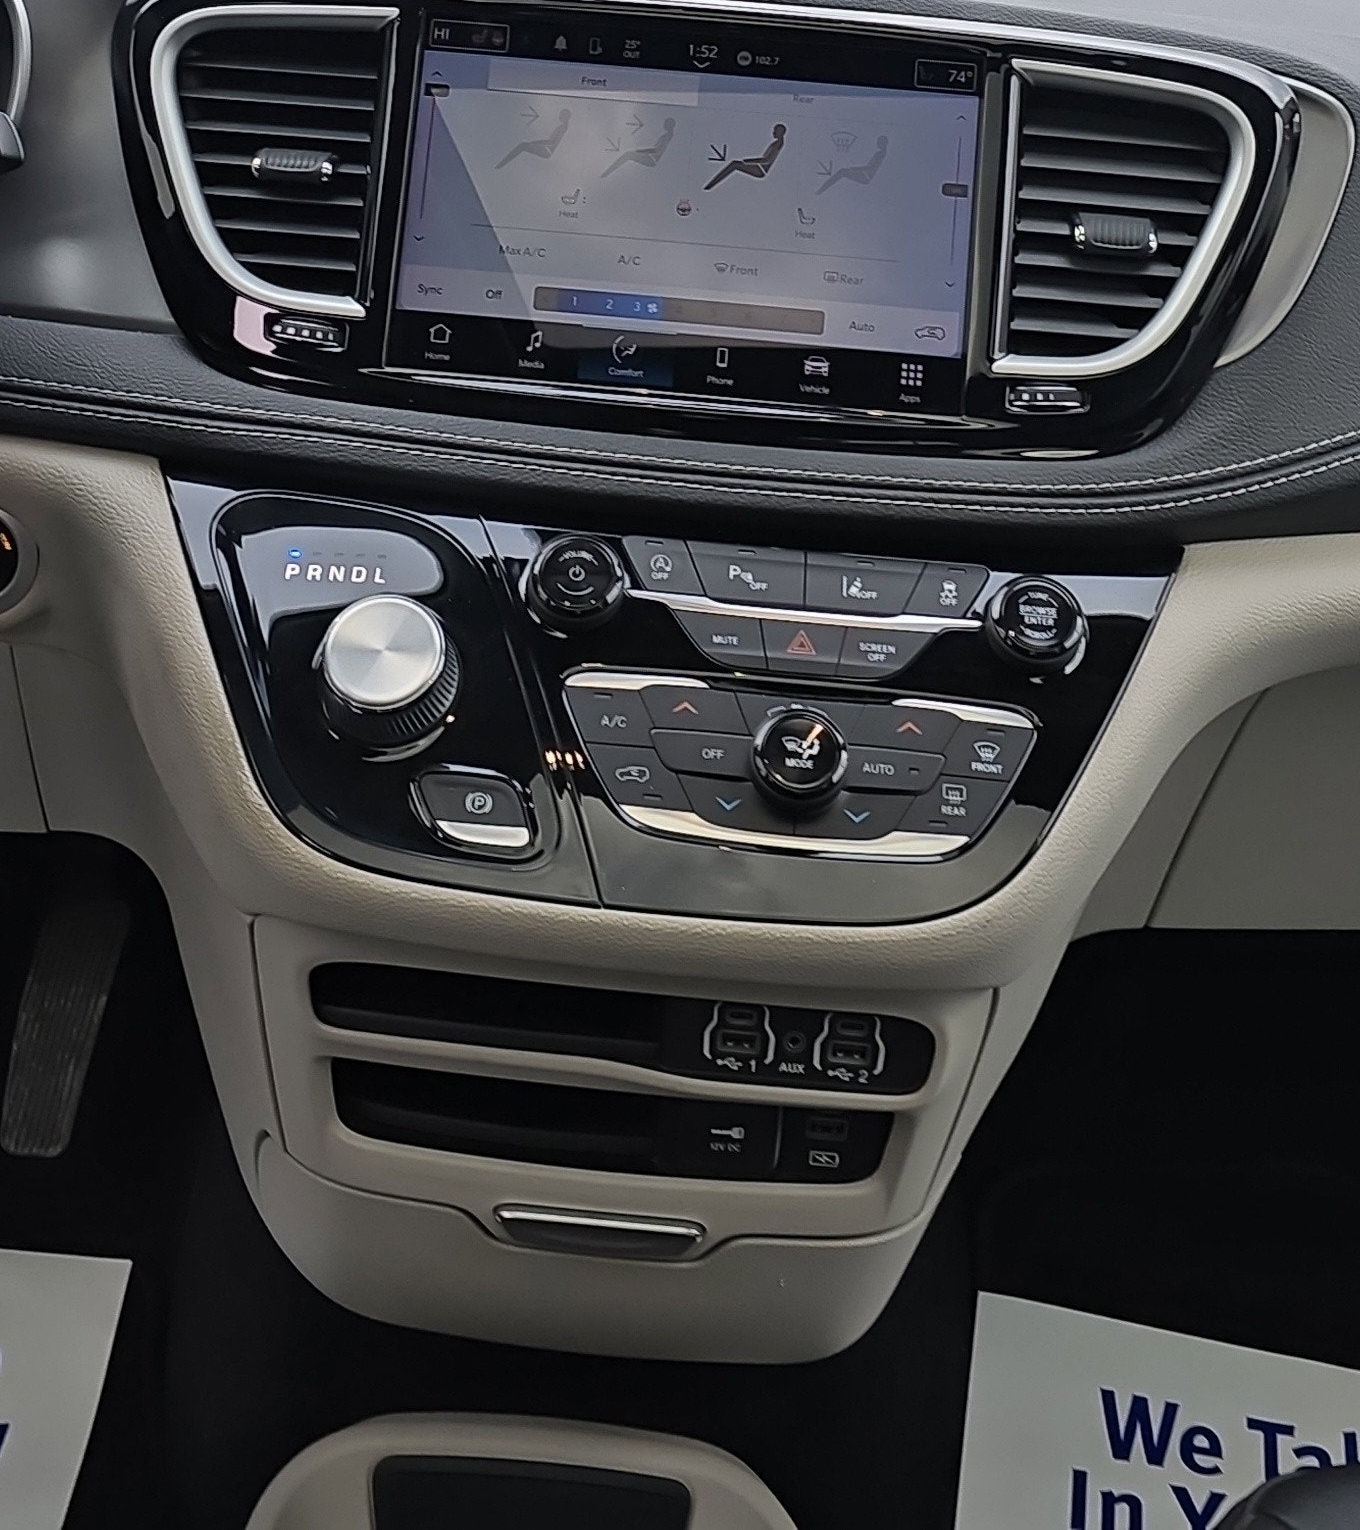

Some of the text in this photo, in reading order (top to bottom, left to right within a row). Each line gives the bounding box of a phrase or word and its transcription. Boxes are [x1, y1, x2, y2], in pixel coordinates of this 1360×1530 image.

[433, 27, 451, 41] HI
[689, 44, 719, 59] 1:52
[755, 55, 780, 66] 102.7
[581, 76, 608, 87] Front
[948, 70, 973, 83] 74°
[792, 94, 815, 104] Rear
[558, 209, 579, 219] Heat
[794, 229, 816, 240] Heat
[499, 244, 547, 258] Max A/C
[617, 254, 642, 266] A/C
[729, 264, 759, 277] Front
[839, 273, 865, 286] Rear
[417, 283, 443, 296] Sync
[485, 289, 504, 300] Off
[605, 298, 614, 310] 2
[848, 321, 875, 333] Auto
[424, 351, 451, 361] Home
[518, 358, 545, 369] Media
[607, 366, 645, 378] Comfort
[706, 374, 734, 386] Phone
[798, 382, 831, 395] Vehicle
[898, 392, 921, 405] Apps
[651, 571, 670, 581] OFF
[712, 634, 739, 646] MUTE
[858, 641, 896, 655] SCREEN
[866, 652, 887, 662] OFF
[600, 715, 627, 728] A/C
[701, 747, 726, 760] OFF
[784, 757, 815, 770] MODE
[862, 761, 895, 776] AUTO
[970, 761, 1004, 774] FRONT
[940, 804, 967, 817] REAR
[778, 1061, 806, 1074] AUX
[1098, 1386, 1226, 1475] We
[1070, 1467, 1144, 1530] In
